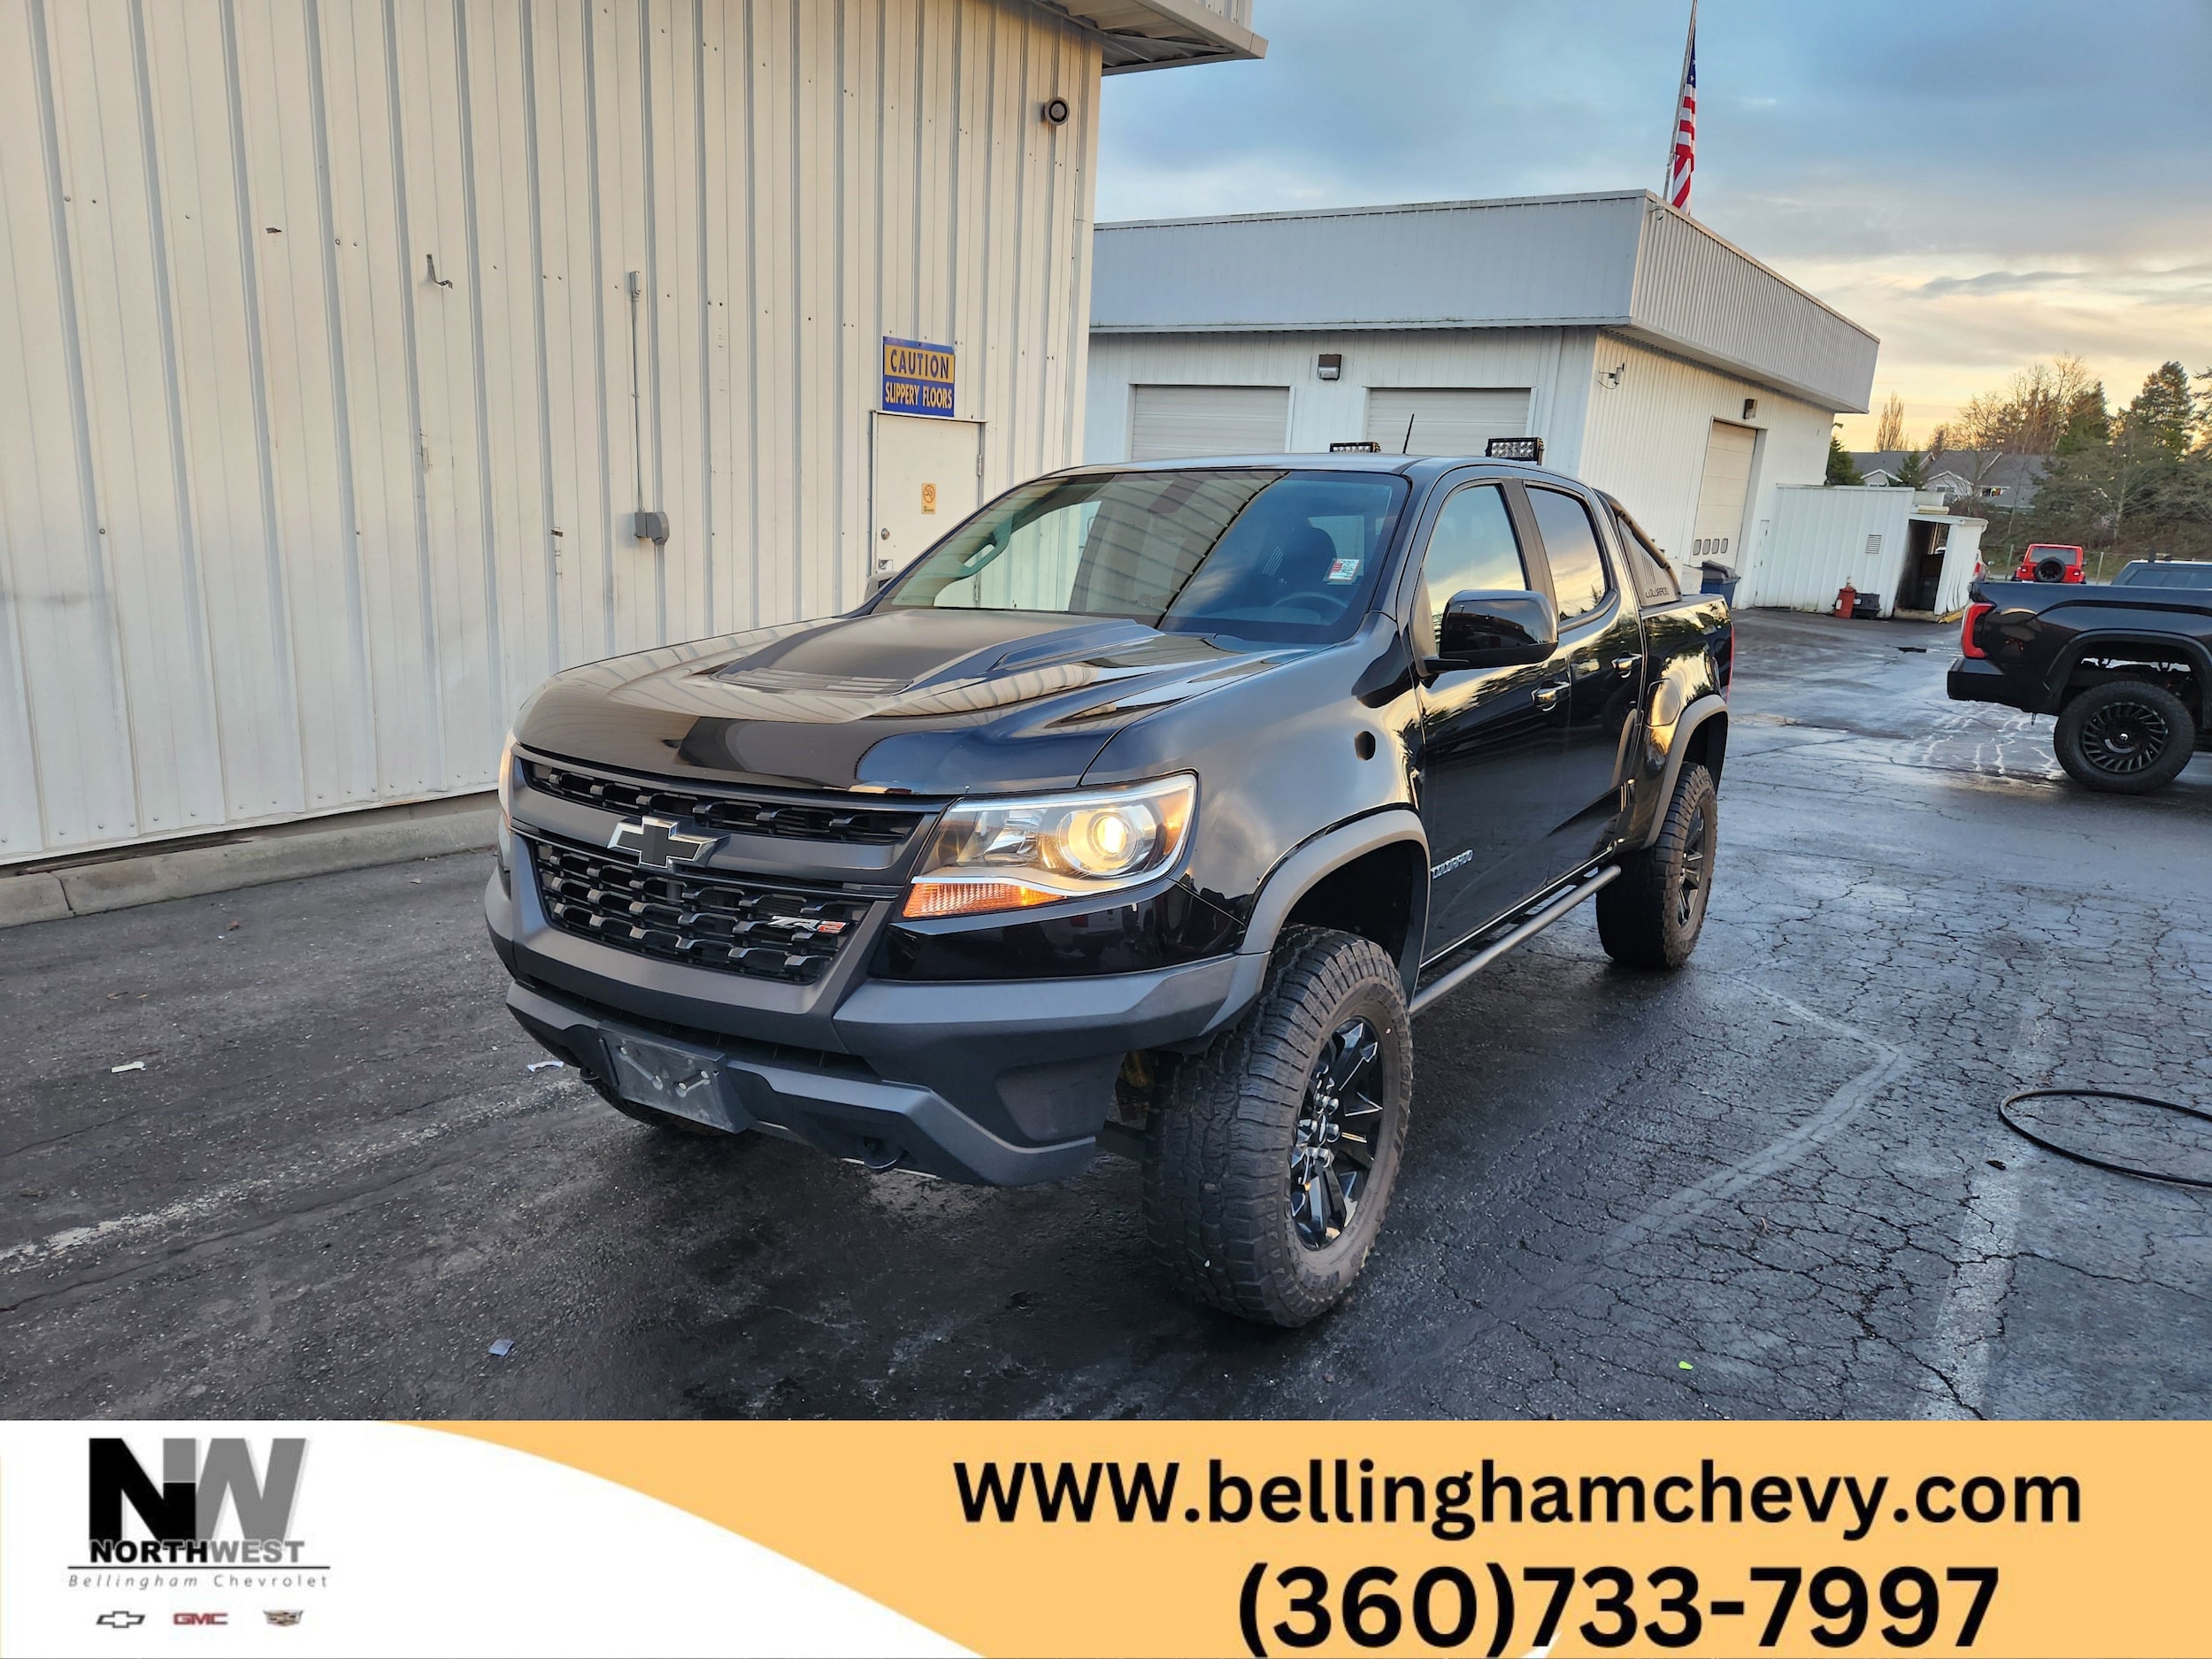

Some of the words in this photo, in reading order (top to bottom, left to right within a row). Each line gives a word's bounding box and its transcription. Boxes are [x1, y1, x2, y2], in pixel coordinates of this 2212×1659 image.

[890, 349, 949, 379] CAUTION
[885, 381, 919, 406] SLIPPERY
[922, 387, 953, 409] FLOORS
[767, 915, 847, 934] ZR2
